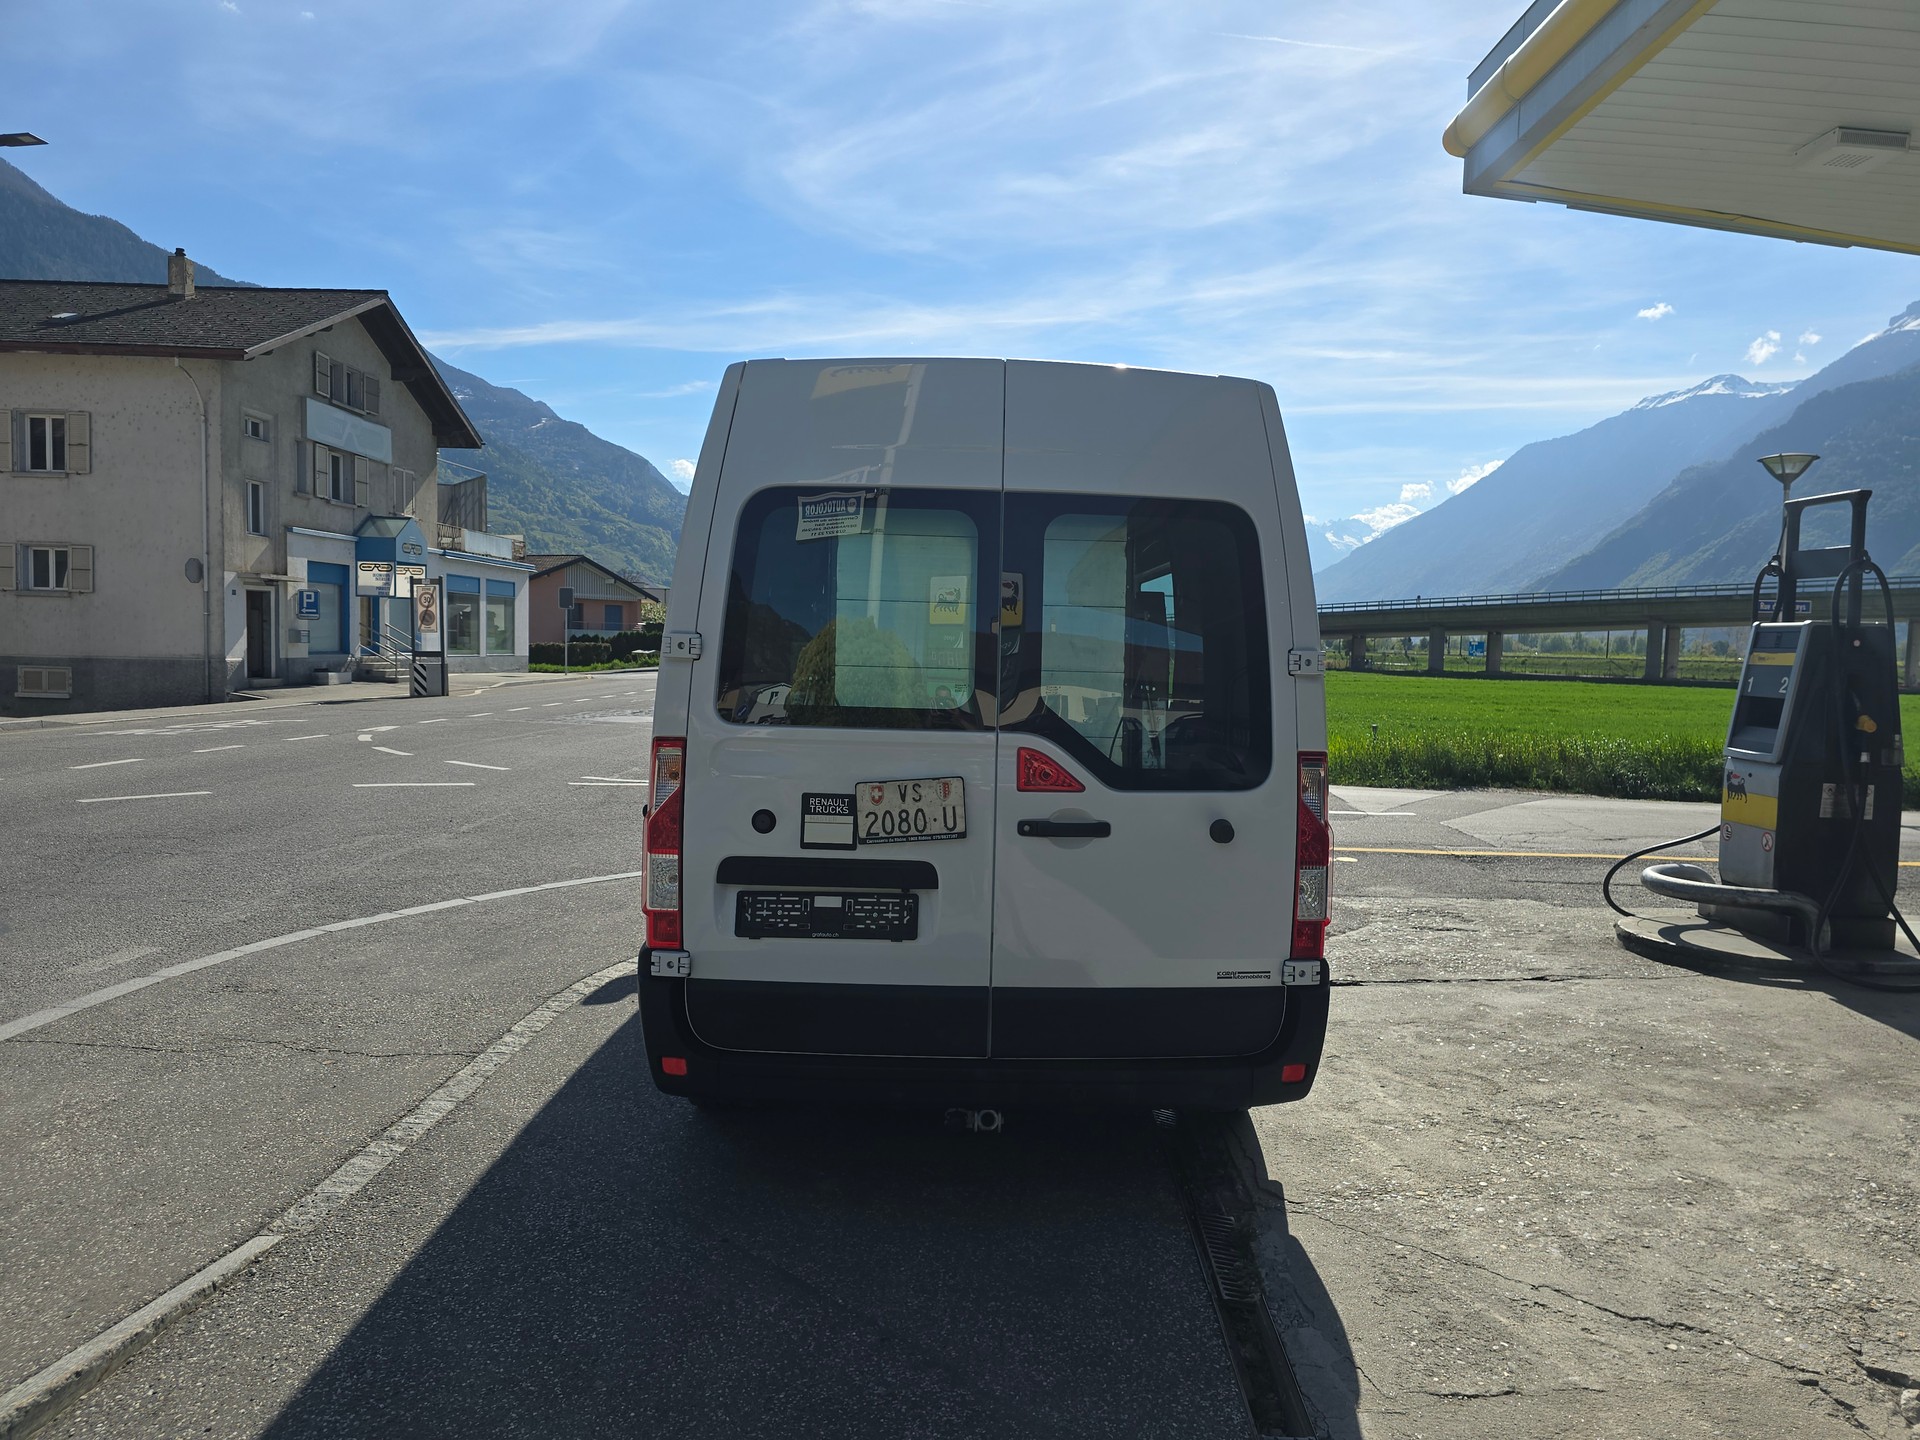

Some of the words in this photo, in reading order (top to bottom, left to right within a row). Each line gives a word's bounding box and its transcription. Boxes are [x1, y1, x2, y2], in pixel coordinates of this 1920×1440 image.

[303, 591, 315, 608] P
[423, 596, 431, 604] 30
[1759, 601, 1771, 610] Rue
[1747, 676, 1754, 693] 1
[1778, 676, 1789, 693] 2
[898, 783, 922, 803] VS
[809, 797, 849, 806] RENAULT
[809, 805, 849, 814] TRUCKS
